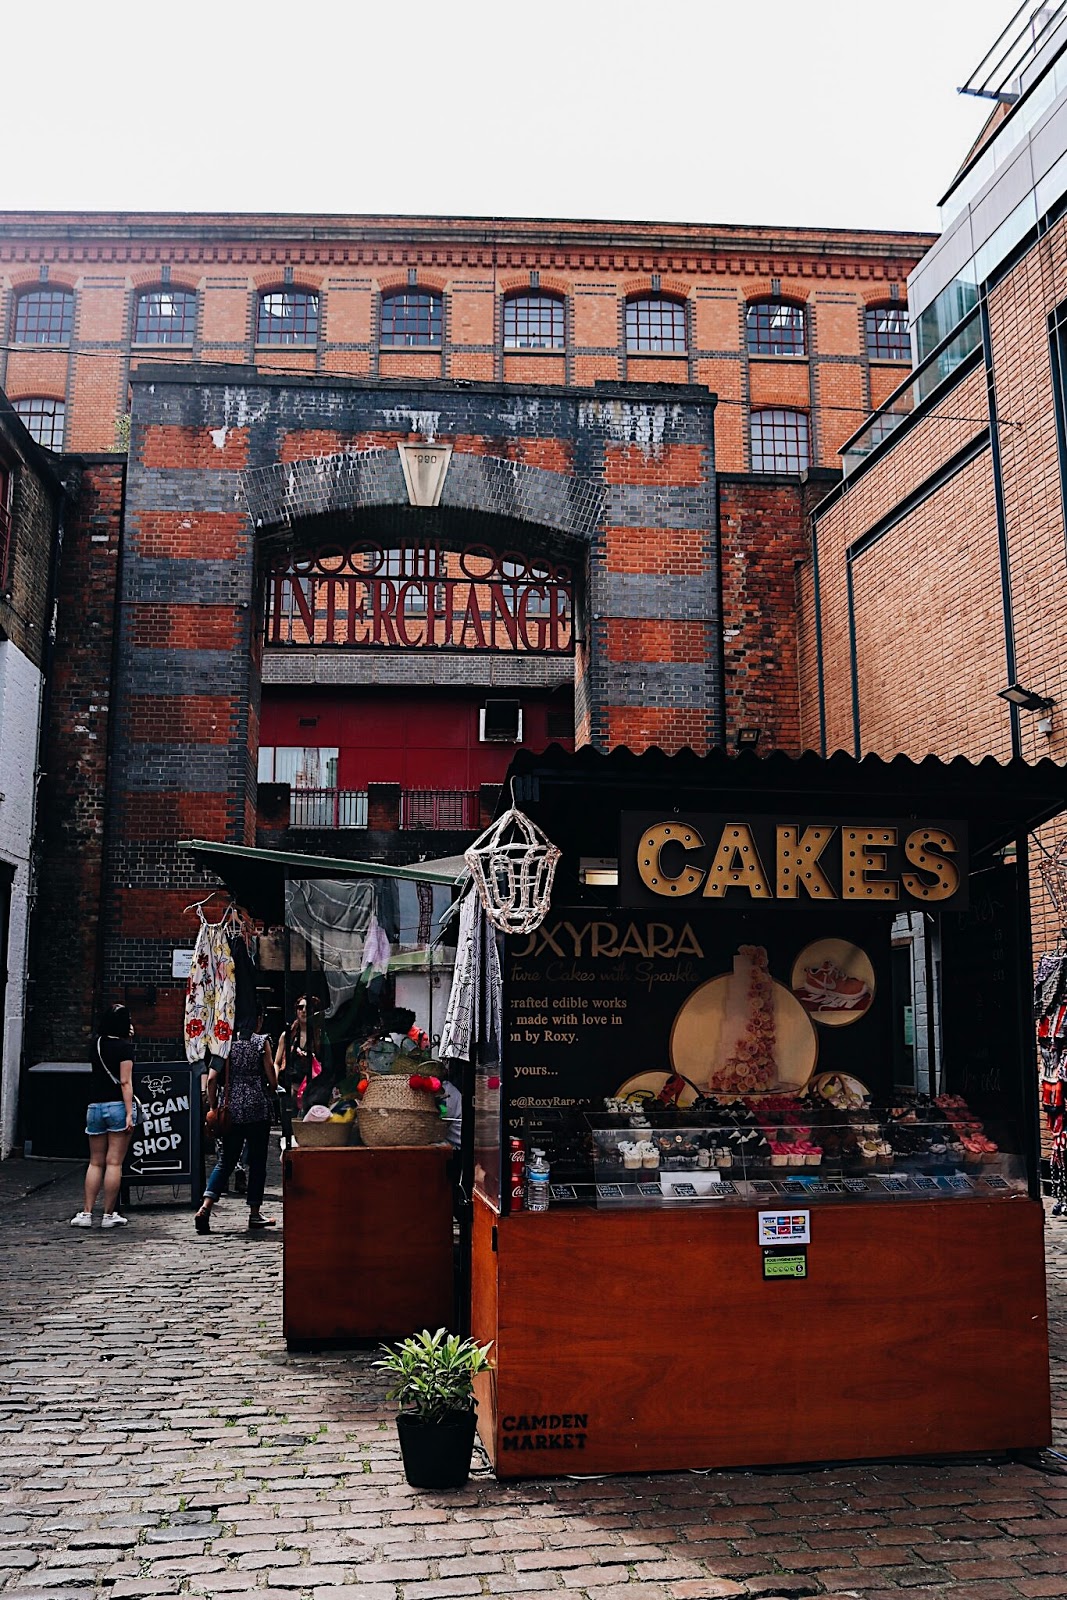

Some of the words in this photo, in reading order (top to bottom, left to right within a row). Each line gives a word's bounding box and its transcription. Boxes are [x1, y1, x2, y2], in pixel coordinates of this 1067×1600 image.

[399, 537, 448, 578] THE
[270, 575, 573, 651] INTERCHANGE
[637, 821, 961, 901] CAKES
[546, 960, 596, 982] Cakes
[634, 961, 700, 992] Sparkle
[552, 997, 588, 1008] edible
[592, 997, 627, 1008] works
[516, 1013, 548, 1025] made
[552, 1014, 578, 1025] with
[582, 1014, 607, 1025] love
[611, 1014, 622, 1025] in
[525, 1030, 540, 1044] by
[544, 1030, 579, 1044] Roxy.
[514, 1066, 558, 1078] yours...
[142, 1095, 190, 1120] EGAN
[143, 1116, 172, 1136] PIE
[133, 1133, 182, 1157] SHOP
[502, 1413, 588, 1432] CAMDEN
[502, 1433, 587, 1451] MARKET
